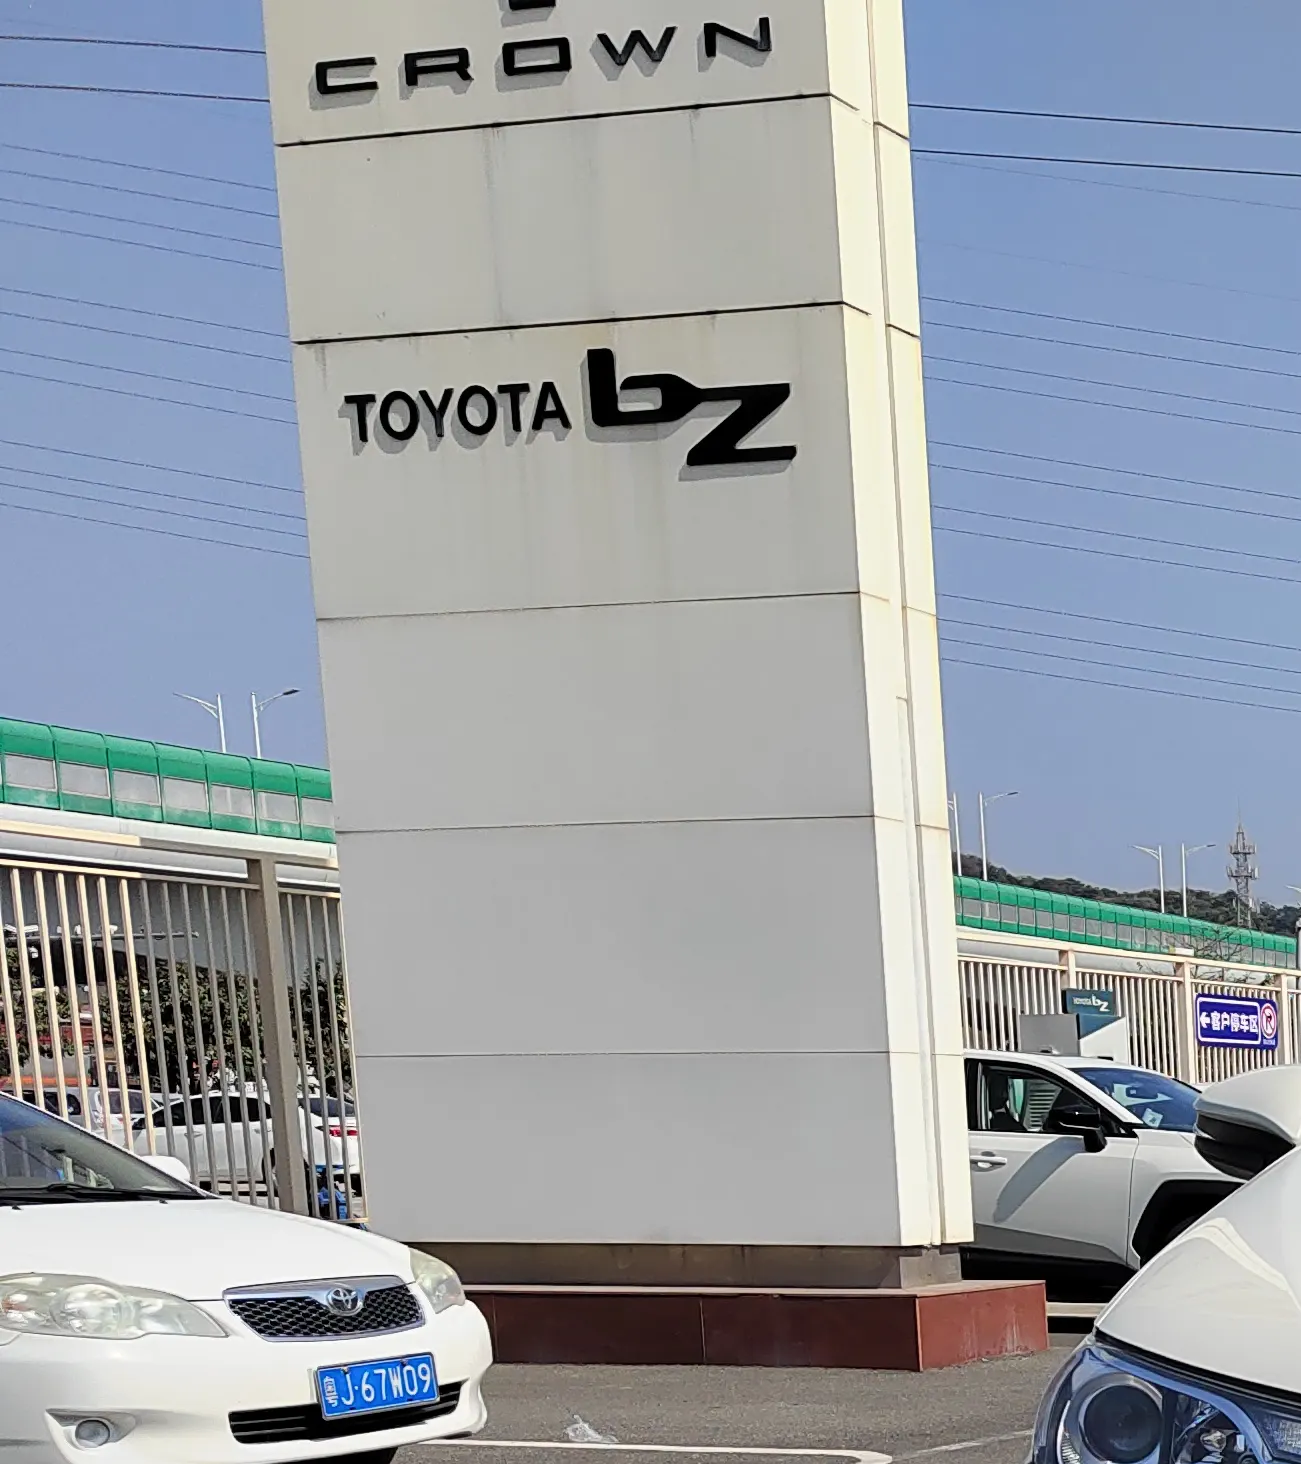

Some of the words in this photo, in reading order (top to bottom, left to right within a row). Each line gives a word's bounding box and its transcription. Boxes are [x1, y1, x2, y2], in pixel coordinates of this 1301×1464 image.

[315, 17, 772, 95] CROWN
[344, 381, 572, 443] TOYOTA
[1211, 1010, 1258, 1033] 客户停车区
